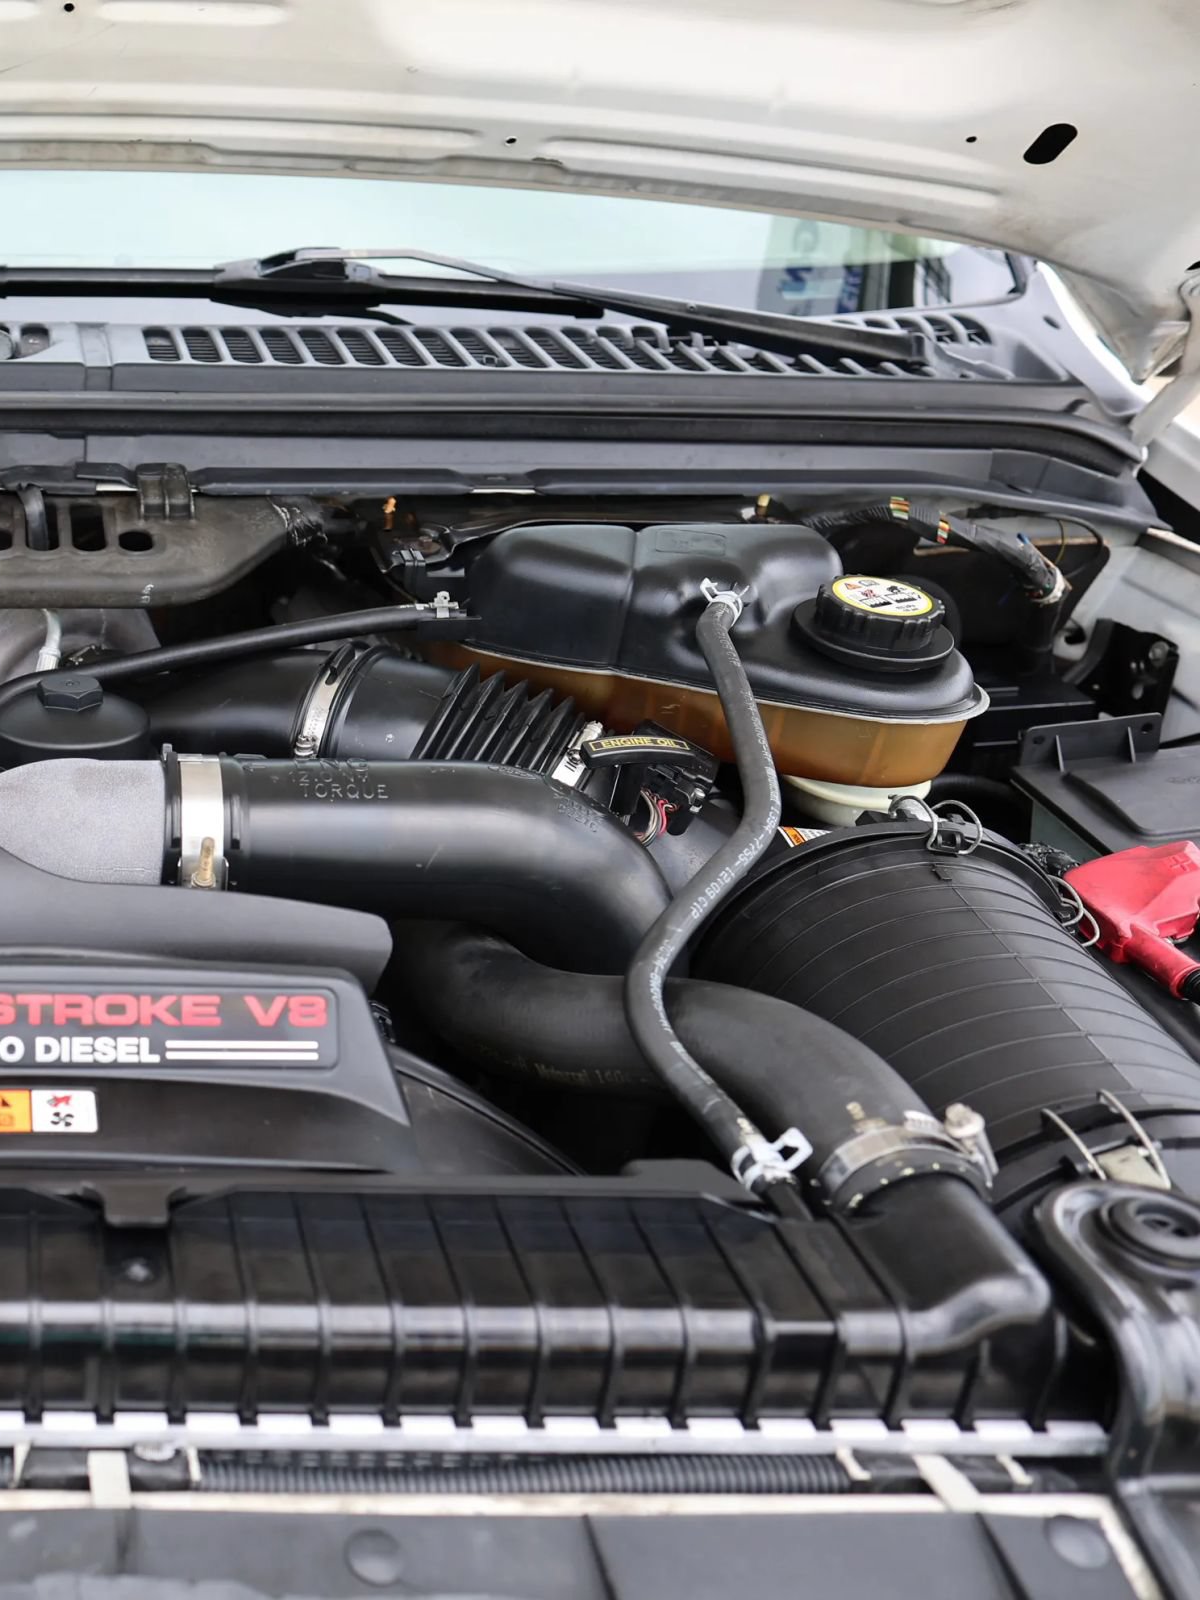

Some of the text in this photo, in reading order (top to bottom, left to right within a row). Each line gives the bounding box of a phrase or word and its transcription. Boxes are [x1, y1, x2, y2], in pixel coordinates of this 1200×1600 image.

[601, 738, 679, 748] ENGINE OIL
[299, 783, 389, 799] TORQUE
[244, 995, 328, 1028] V8
[34, 1036, 161, 1063] DIESEL
